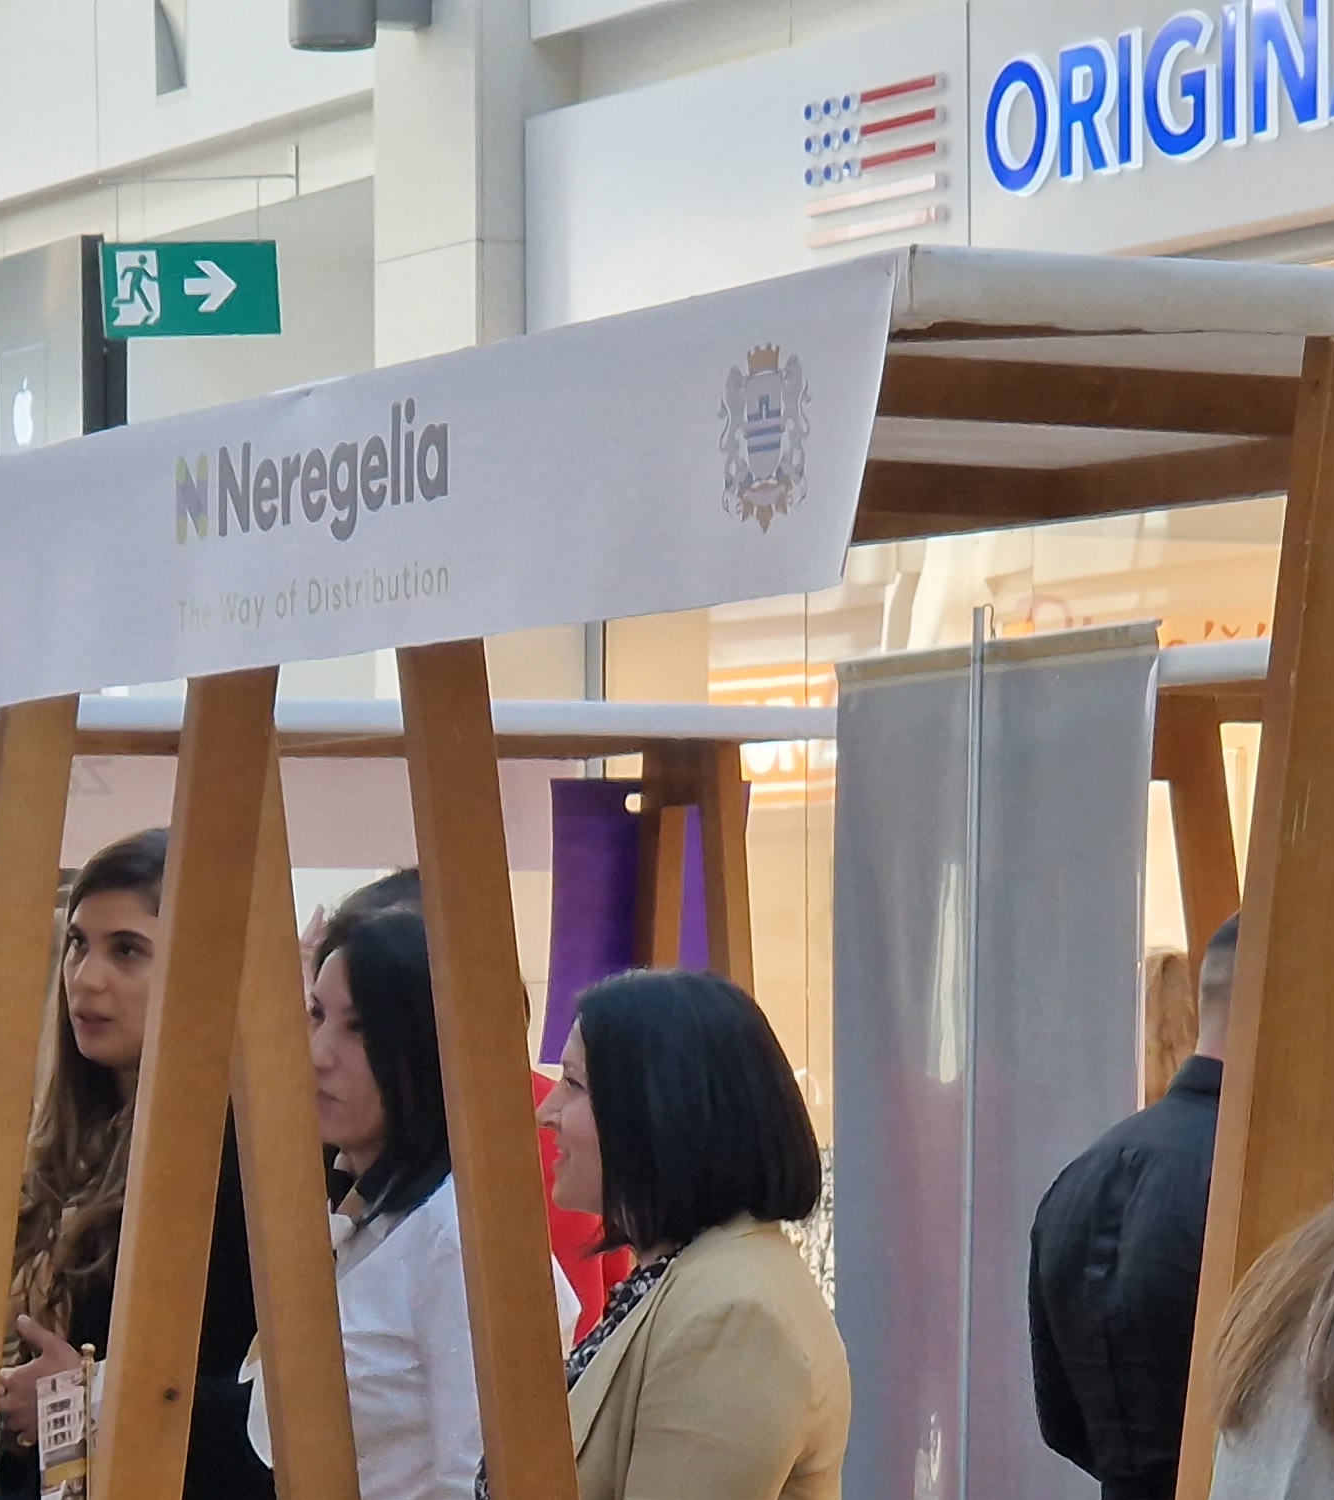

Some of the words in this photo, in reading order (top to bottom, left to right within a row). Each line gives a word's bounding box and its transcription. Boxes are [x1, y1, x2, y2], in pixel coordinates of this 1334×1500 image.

[218, 397, 450, 542] Neregelia
[220, 594, 265, 629] Way
[275, 578, 298, 619] of
[308, 562, 450, 615] Distribution
